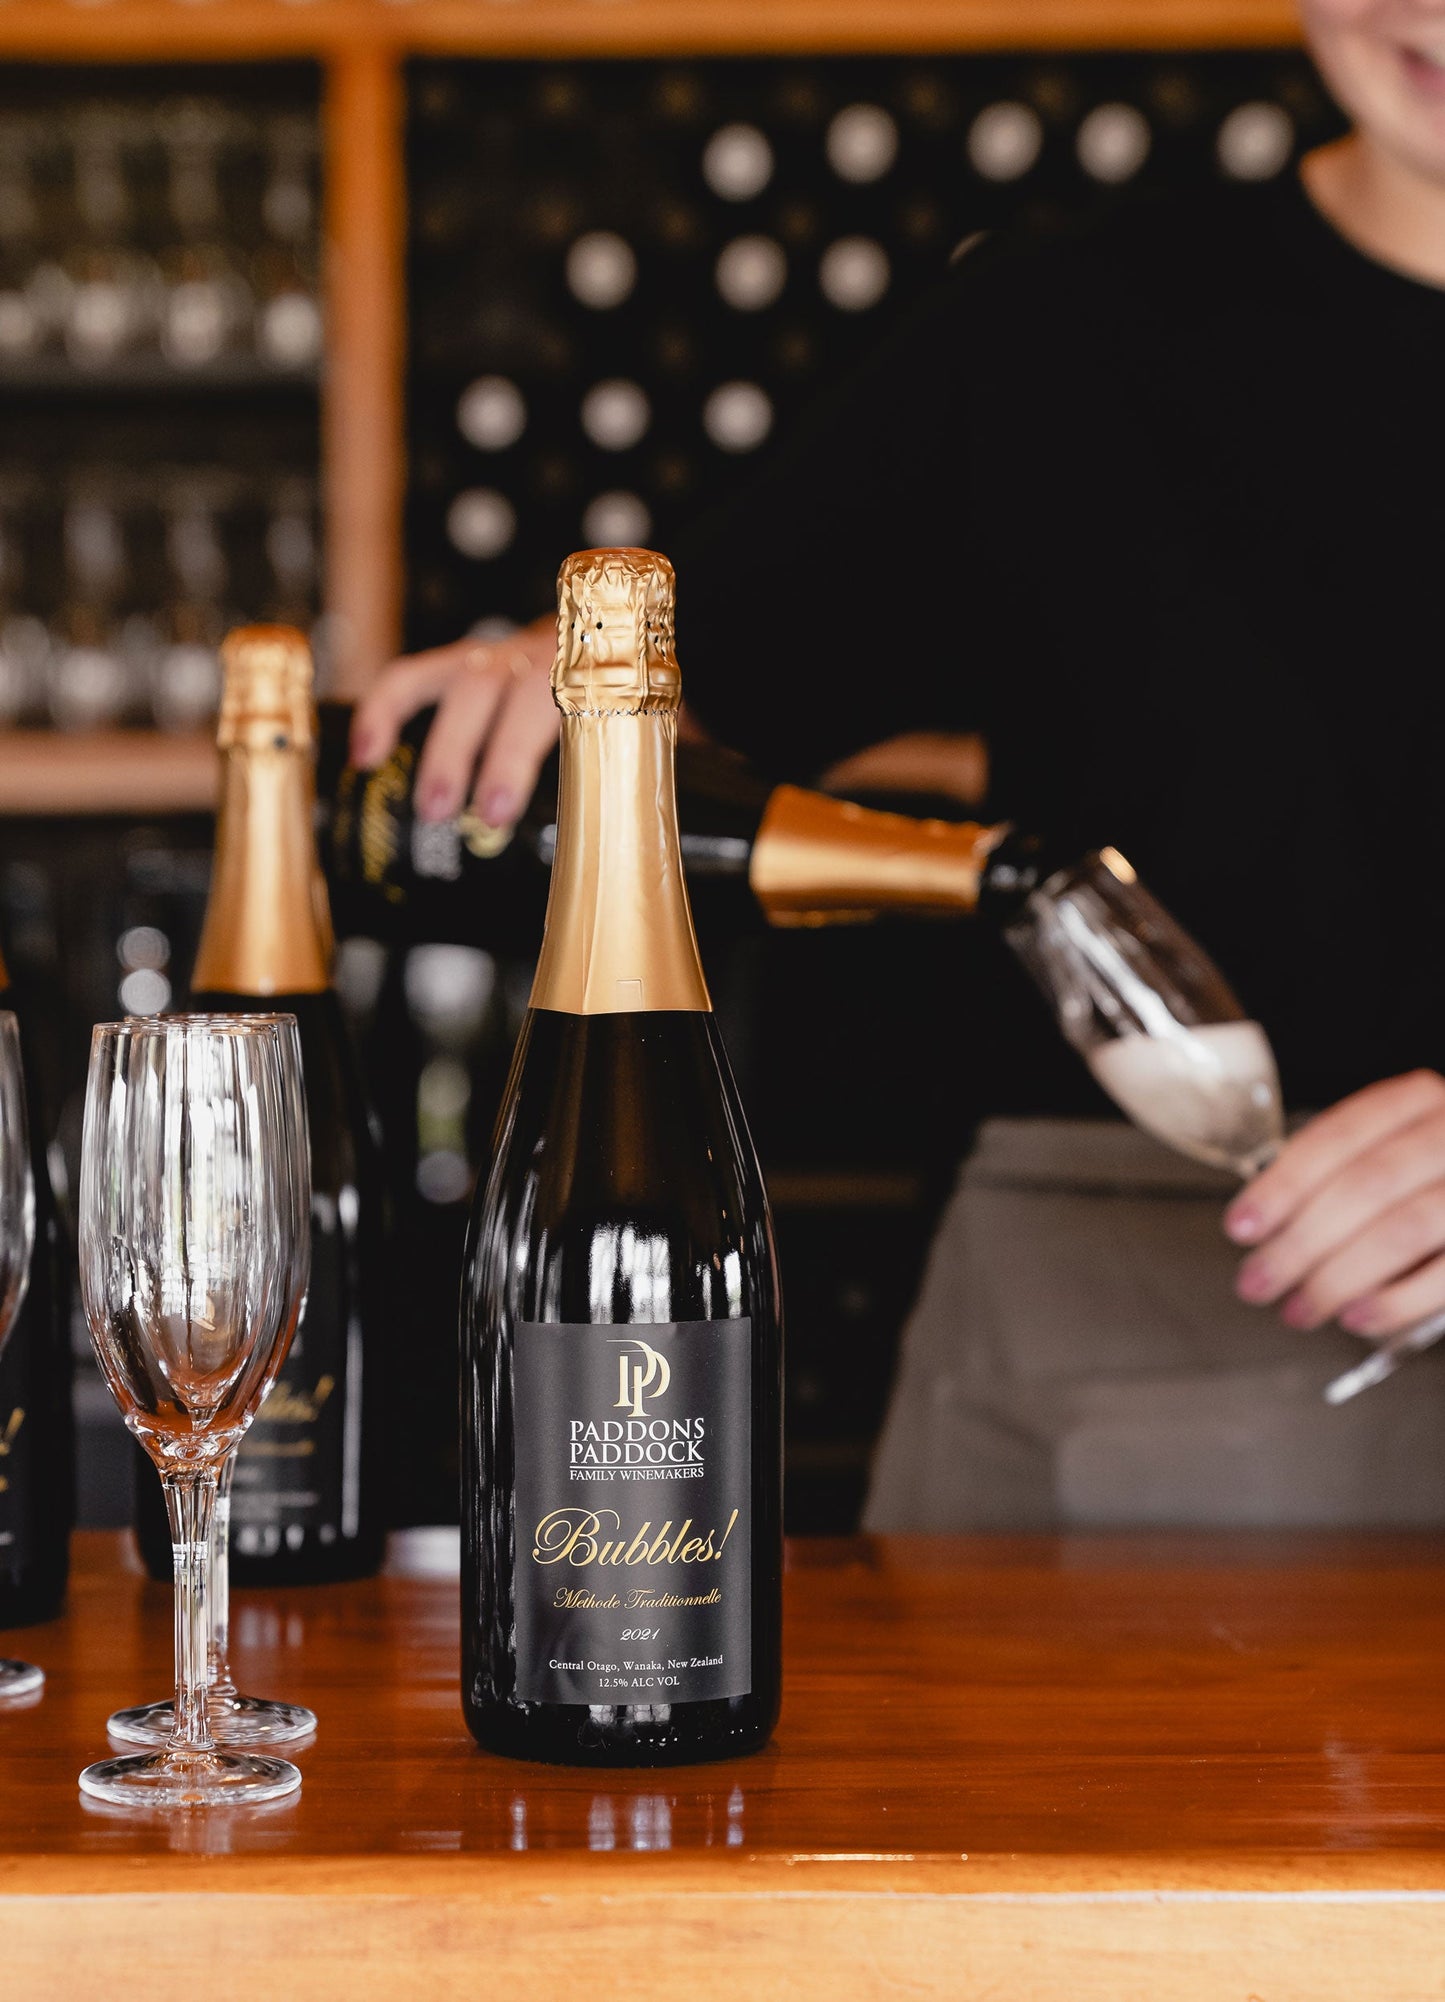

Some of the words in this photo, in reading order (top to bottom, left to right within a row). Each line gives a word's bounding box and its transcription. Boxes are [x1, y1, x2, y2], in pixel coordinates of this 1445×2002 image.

[570, 1418, 705, 1441] PADDONS
[570, 1441, 704, 1464] PADDOCK
[570, 1470, 616, 1481] FAMILY
[621, 1467, 704, 1480] WINEMAKERS
[532, 1507, 739, 1567] Bubbles!
[553, 1587, 621, 1609] Methode
[624, 1588, 722, 1609] Traditionnelle
[620, 1628, 660, 1641] 2021
[549, 1659, 584, 1671] Central
[587, 1660, 620, 1673] Otago,
[623, 1660, 665, 1672] Wanaka,
[667, 1659, 688, 1669] New
[690, 1655, 723, 1668] Zealand
[599, 1678, 628, 1688] 12.5%
[631, 1677, 654, 1687] ALC
[657, 1676, 680, 1686] VOL
